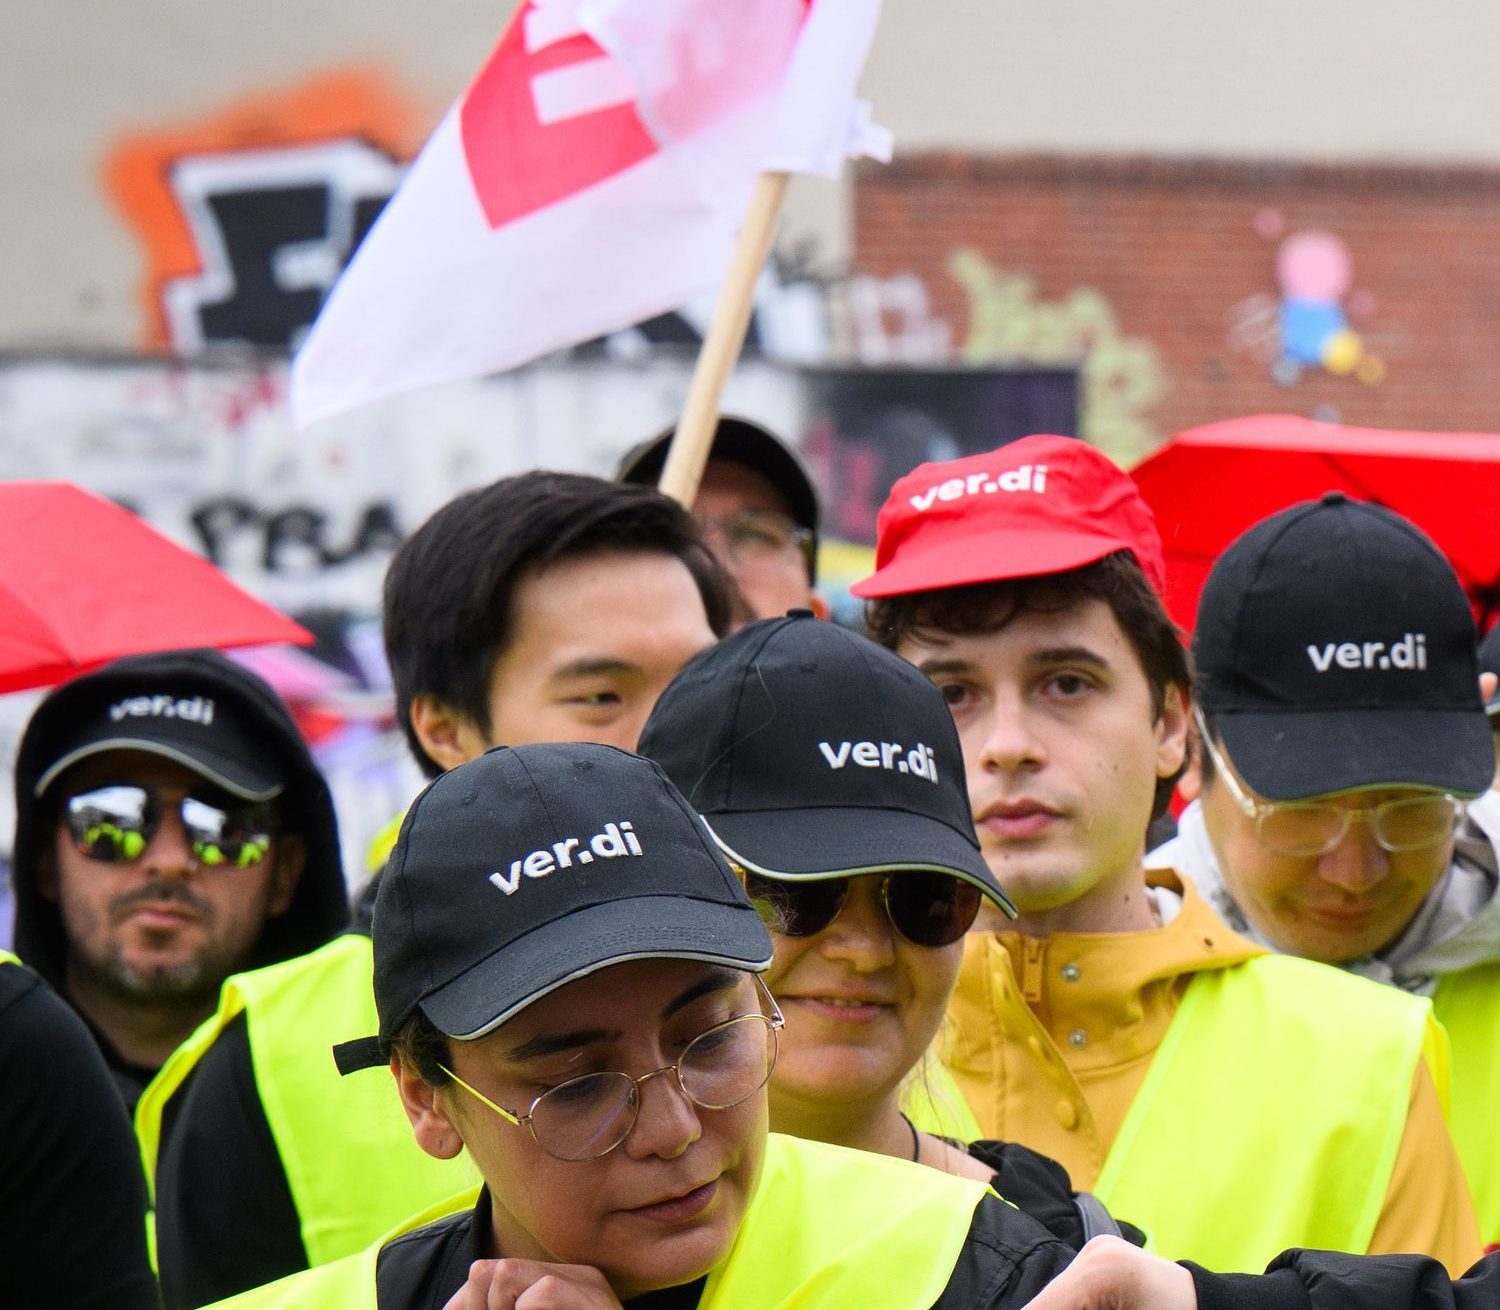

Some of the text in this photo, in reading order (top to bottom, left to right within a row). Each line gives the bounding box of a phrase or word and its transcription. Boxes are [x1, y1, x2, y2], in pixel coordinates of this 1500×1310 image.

[910, 464, 1049, 512] ver.di
[1307, 633, 1427, 672] ver.di
[110, 695, 214, 726] ver.di
[818, 740, 939, 785] ver.di
[489, 820, 644, 896] ver.di
